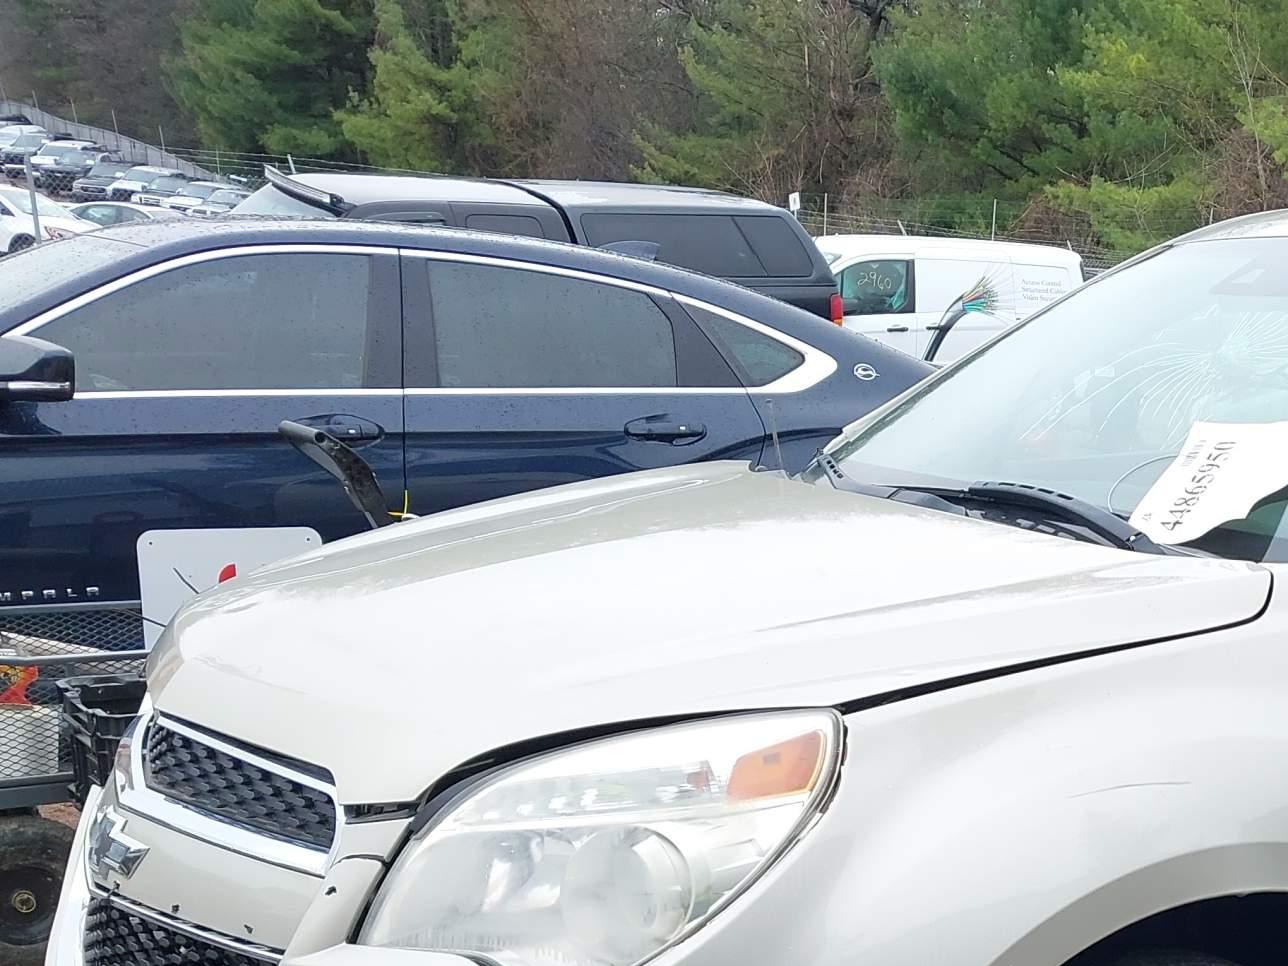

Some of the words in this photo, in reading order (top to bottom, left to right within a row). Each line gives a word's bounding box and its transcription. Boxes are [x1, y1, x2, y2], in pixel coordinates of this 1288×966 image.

[857, 271, 892, 289] 2960
[1160, 441, 1237, 531] 44865950
[0, 586, 100, 602] MPALA
